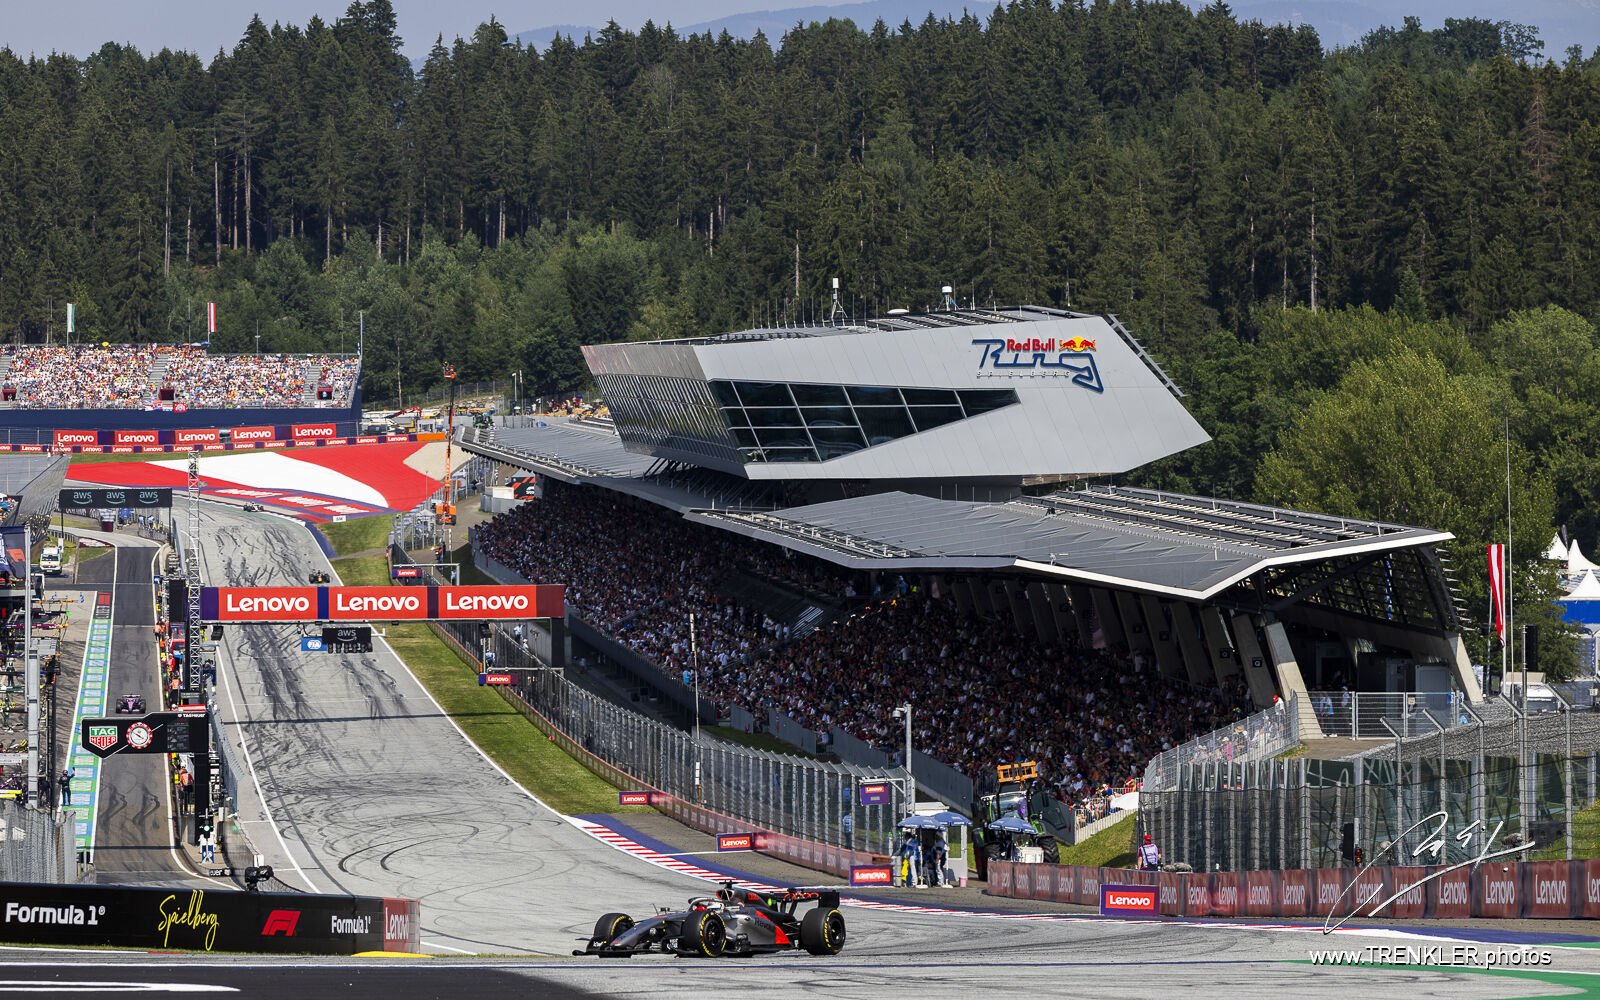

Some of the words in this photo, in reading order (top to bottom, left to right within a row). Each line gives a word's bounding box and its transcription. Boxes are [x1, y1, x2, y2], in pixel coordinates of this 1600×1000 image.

[1006, 338, 1031, 352] Red
[1032, 338, 1055, 352] Bull
[58, 433, 94, 442] Lenovo
[118, 434, 156, 442] Lenovo
[178, 432, 216, 441] Lenovo
[234, 430, 272, 439] Lenovo
[296, 427, 332, 436] Lenovo
[227, 594, 309, 612] Lenovo
[337, 593, 420, 611] Lenovo
[446, 592, 528, 610] Lenovo
[90, 736, 116, 750] HEUER
[856, 872, 886, 880] Lenovo
[1188, 882, 1207, 904] Lenovo
[1218, 882, 1238, 905] Lenovo
[1248, 881, 1270, 905] Lenovo
[1282, 880, 1306, 904] Lenovo
[1318, 878, 1340, 904] Lenovo
[1356, 878, 1381, 904] Lenovo
[1396, 877, 1422, 904] Lenovo
[1439, 876, 1467, 904] Lenovo
[1486, 875, 1514, 904] Lenovo
[1536, 874, 1566, 904] Lenovo
[1110, 894, 1150, 906] Lenovo
[6, 902, 84, 924] Formula
[158, 889, 220, 951] Spielberg
[332, 916, 364, 934] Formula
